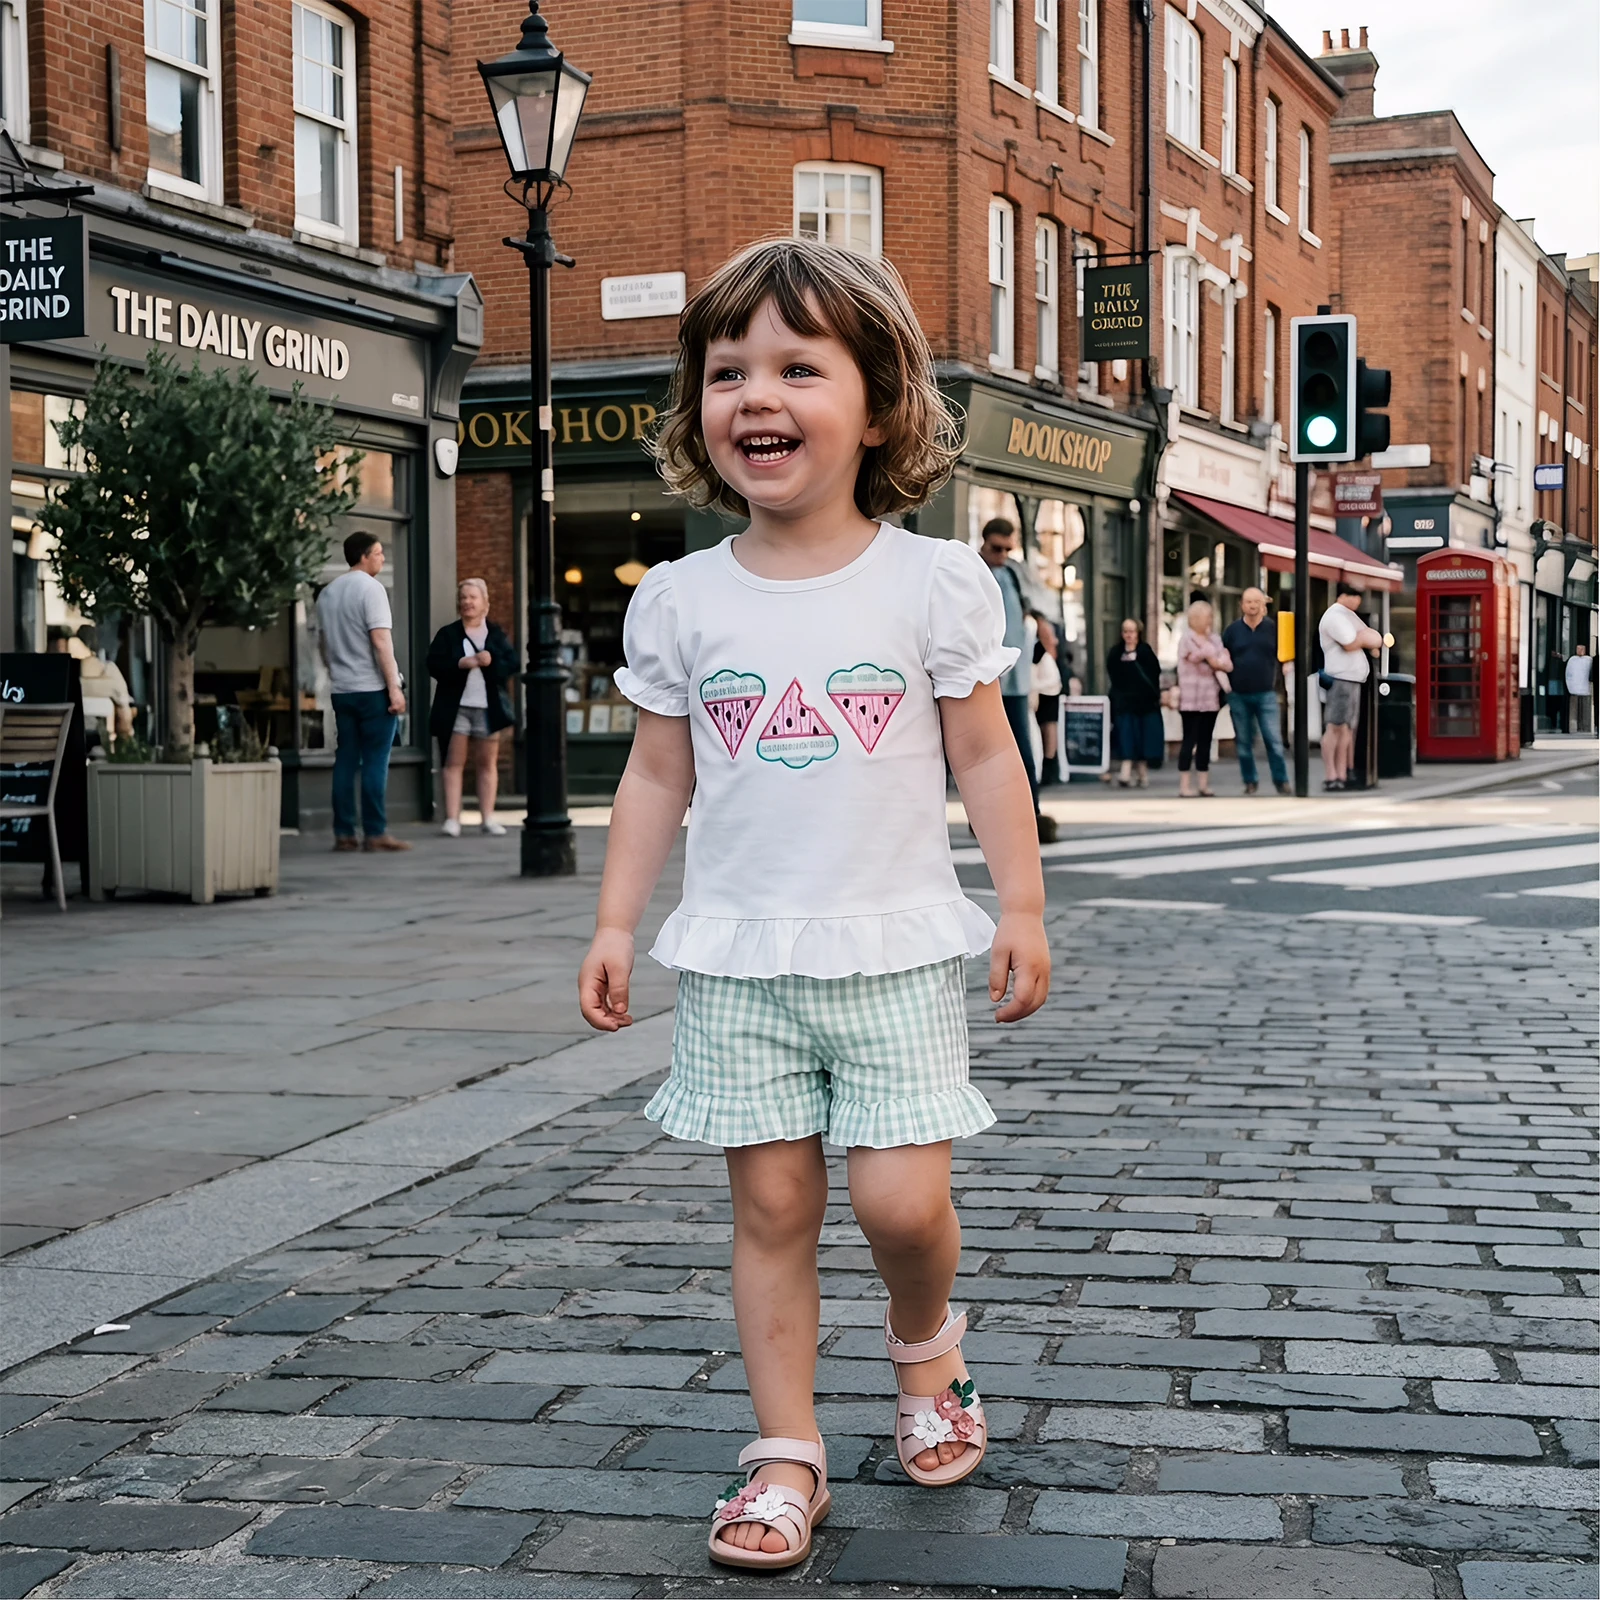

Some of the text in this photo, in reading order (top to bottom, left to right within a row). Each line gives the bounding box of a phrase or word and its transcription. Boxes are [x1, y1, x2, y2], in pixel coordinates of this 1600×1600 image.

[5, 237, 54, 262] THE
[111, 286, 350, 381] THE DAILY GRIND
[1007, 417, 1112, 473] BOOKSHOP
